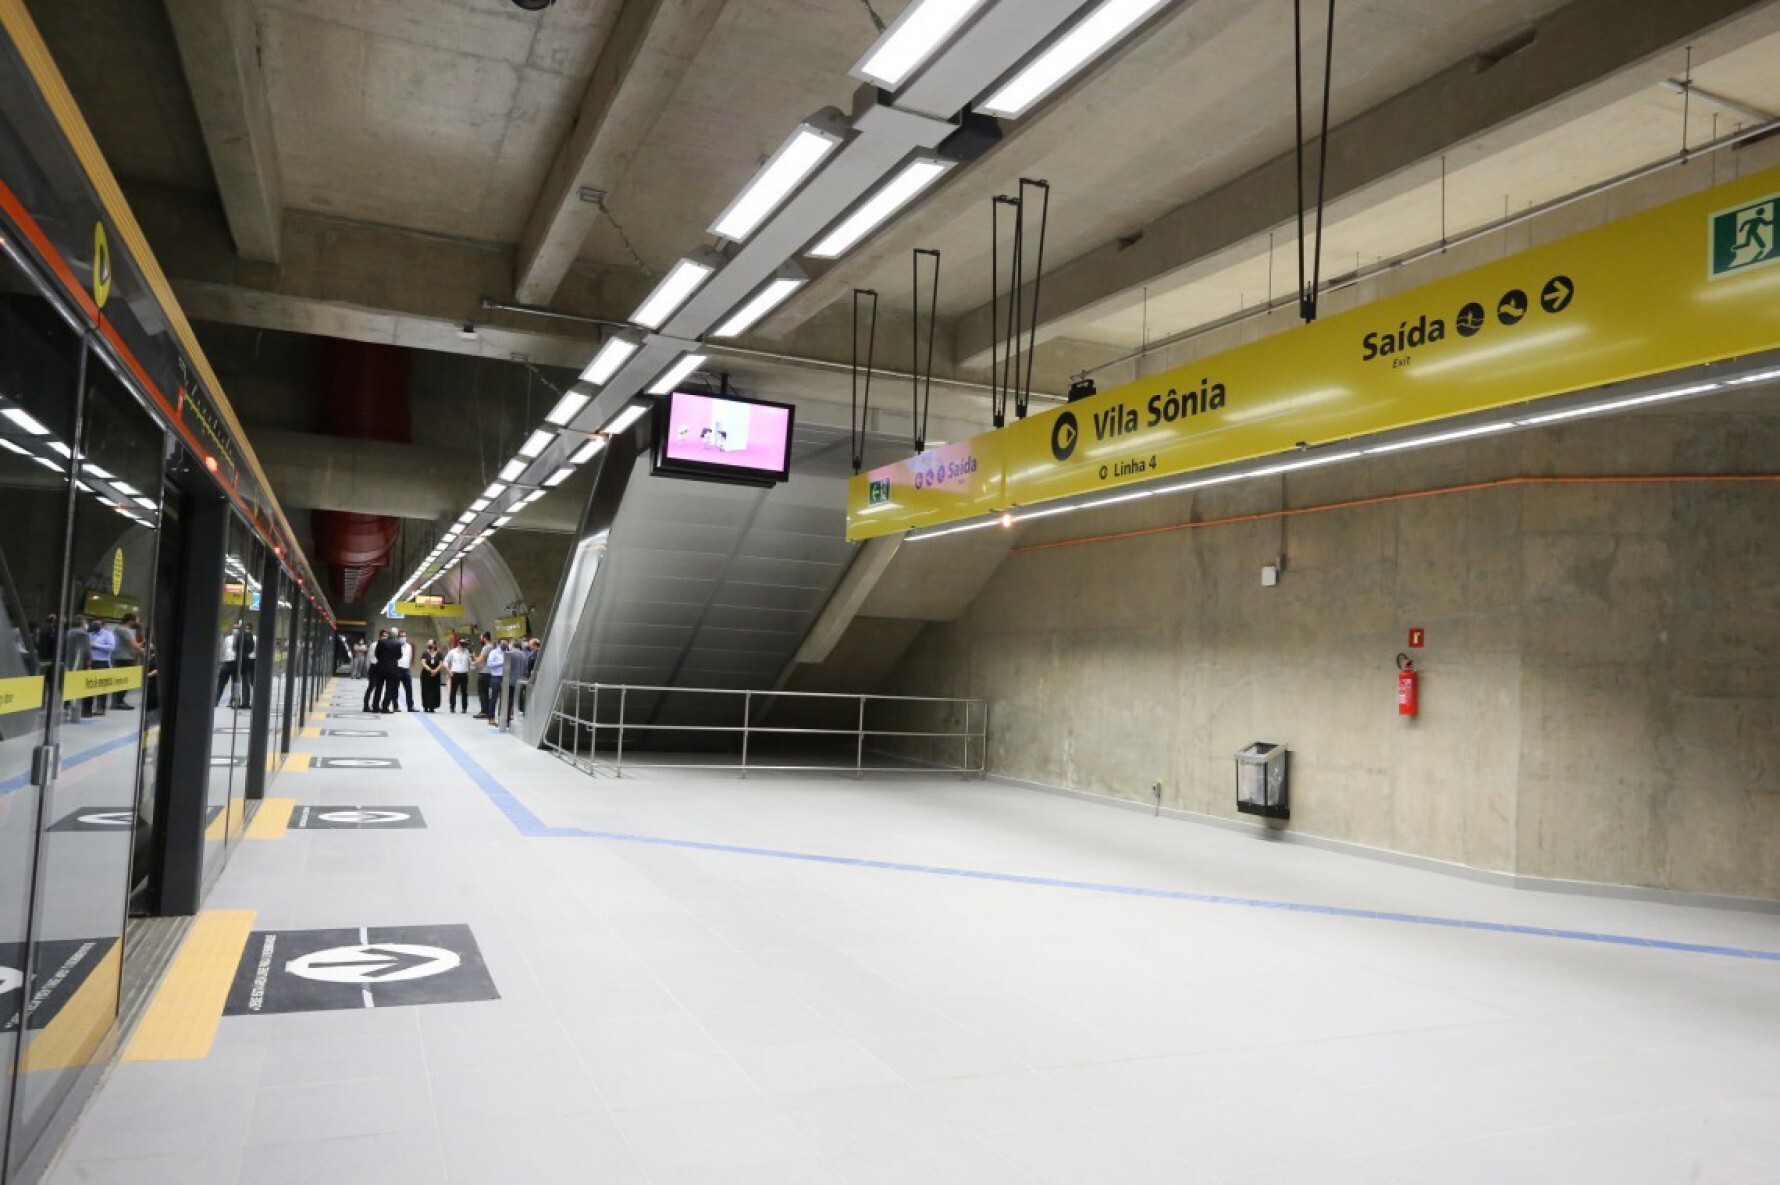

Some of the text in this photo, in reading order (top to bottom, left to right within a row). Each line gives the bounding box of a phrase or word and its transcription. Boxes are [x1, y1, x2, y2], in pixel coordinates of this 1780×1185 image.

[1362, 315, 1445, 361] Saída
[1392, 356, 1411, 369] Exit
[1093, 378, 1226, 440] Vila Sônia
[948, 456, 977, 479] Saída
[1114, 455, 1157, 477] Linha 4
